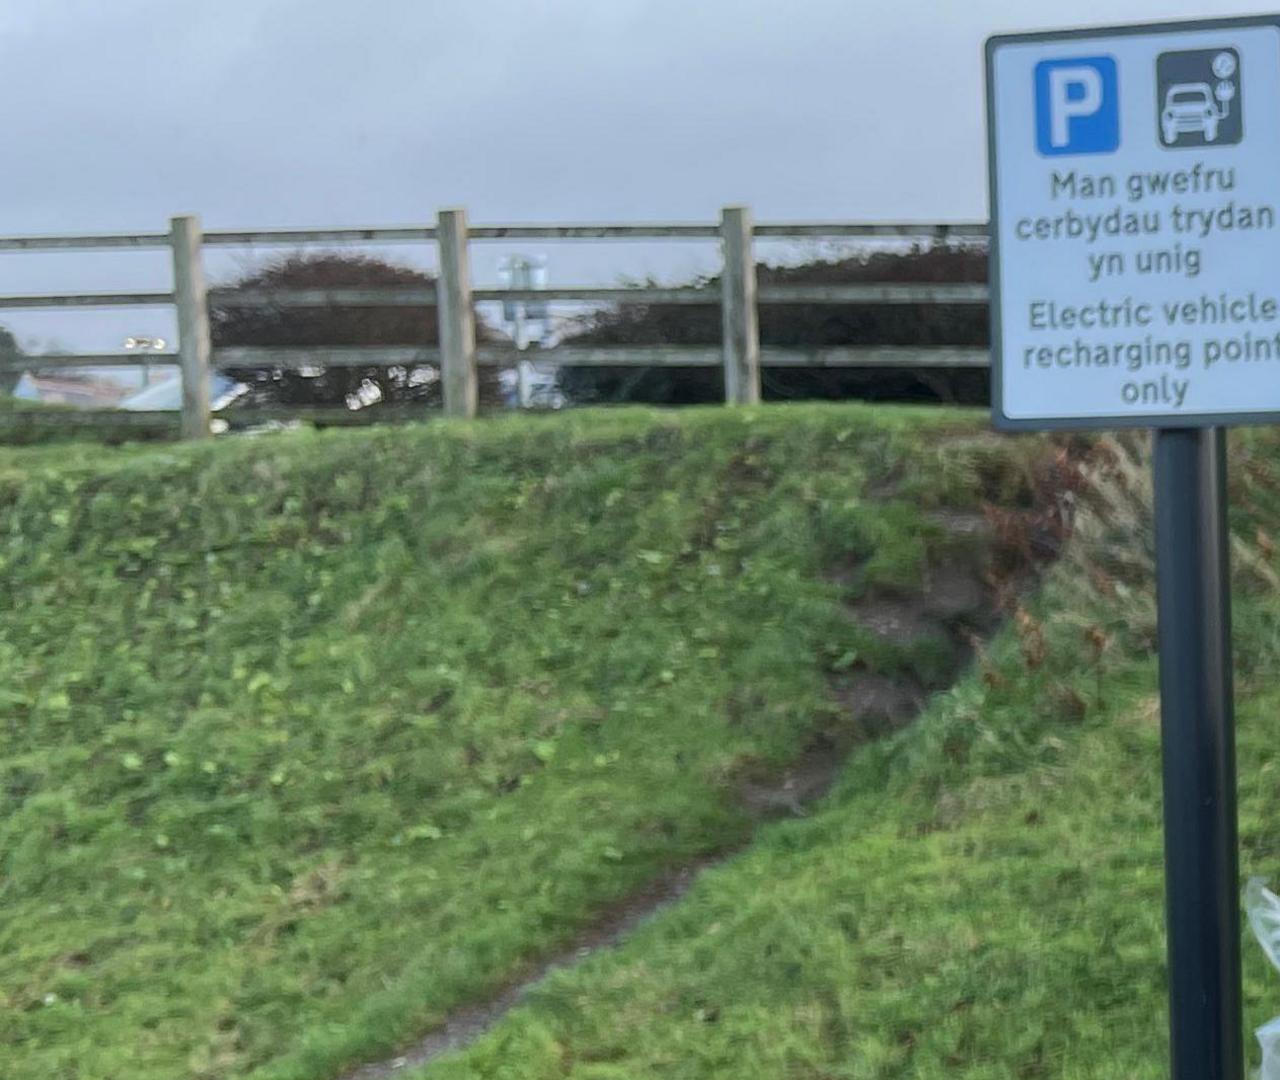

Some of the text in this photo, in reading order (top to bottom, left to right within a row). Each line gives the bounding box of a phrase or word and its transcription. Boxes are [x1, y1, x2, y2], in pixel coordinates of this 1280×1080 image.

[1049, 65, 1102, 147] P
[1050, 162, 1235, 200] Man gwefru
[1015, 203, 1275, 241] cerbydau trydan
[1089, 243, 1200, 281] yn unig
[1029, 294, 1277, 330] Electric vehicle
[1023, 336, 1191, 369] recharging
[1121, 377, 1189, 408] only
